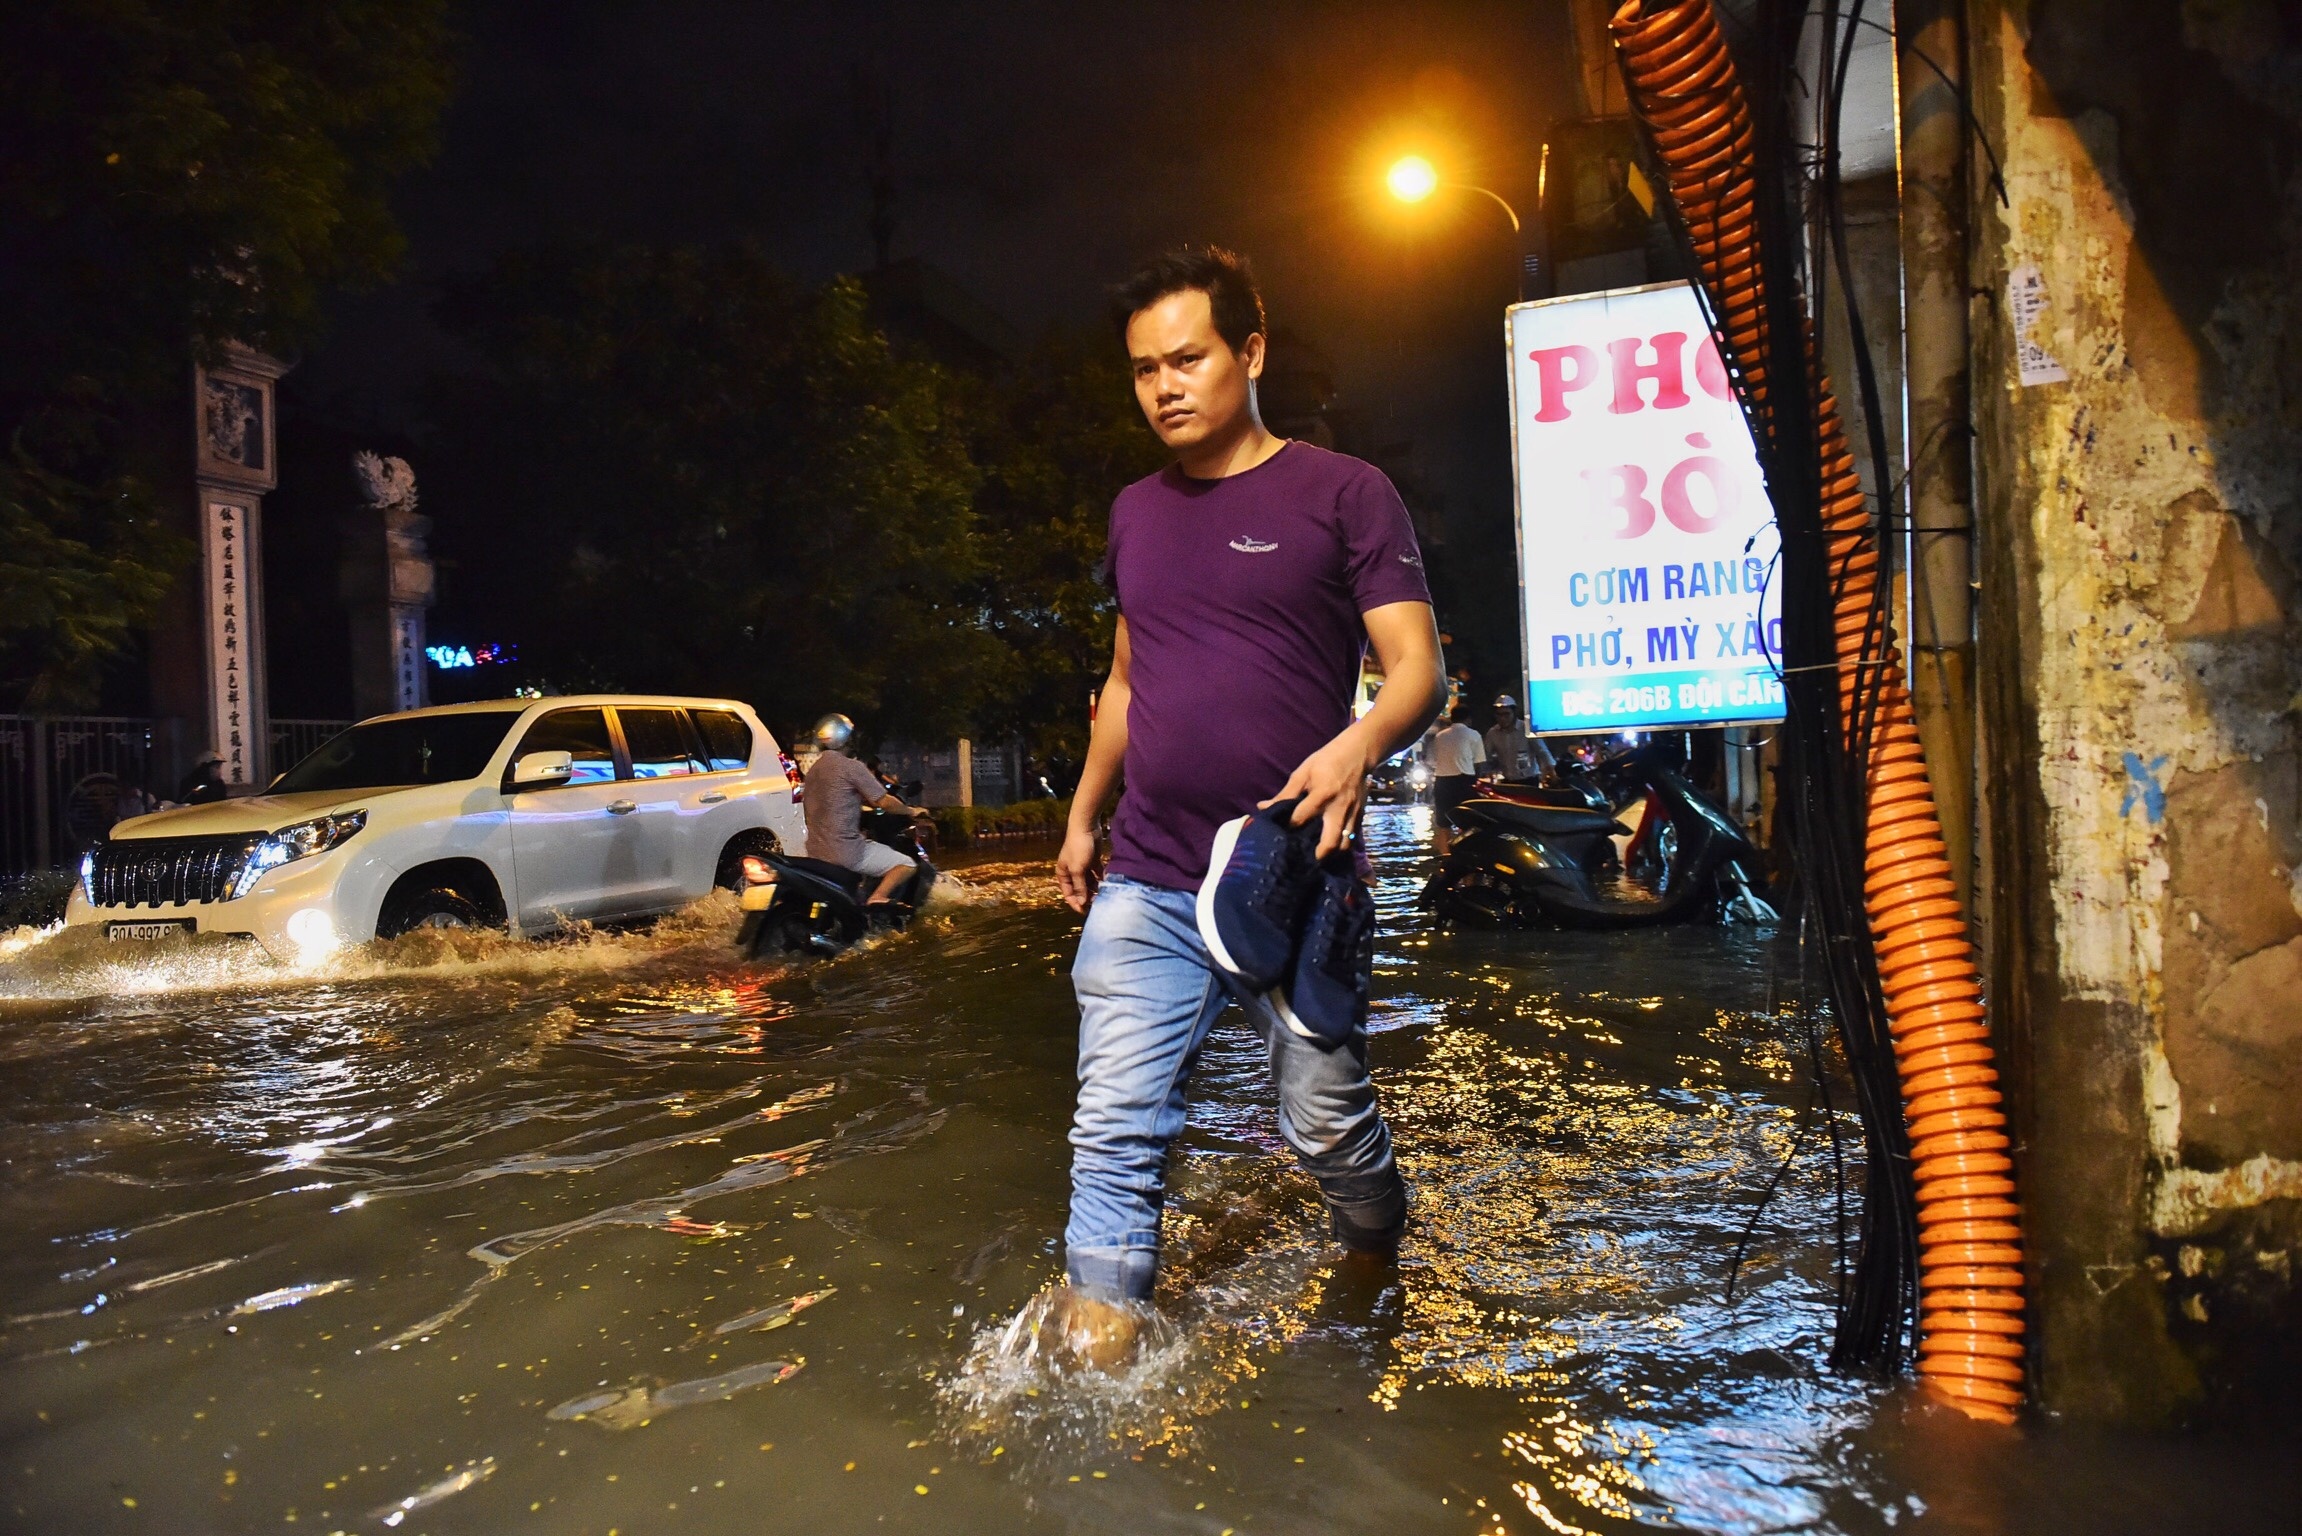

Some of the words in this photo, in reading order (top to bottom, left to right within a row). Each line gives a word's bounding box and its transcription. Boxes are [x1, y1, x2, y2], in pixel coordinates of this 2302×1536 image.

[1579, 432, 1742, 539] BÒ
[1570, 567, 1649, 607] CƠM
[1663, 557, 1766, 600] RANG
[1552, 615, 1633, 669] PHỞ,
[1647, 616, 1700, 663] MỲ
[1716, 613, 1783, 658] XÀO
[1609, 685, 1671, 714] 206B
[1678, 676, 1722, 713] ĐỘI
